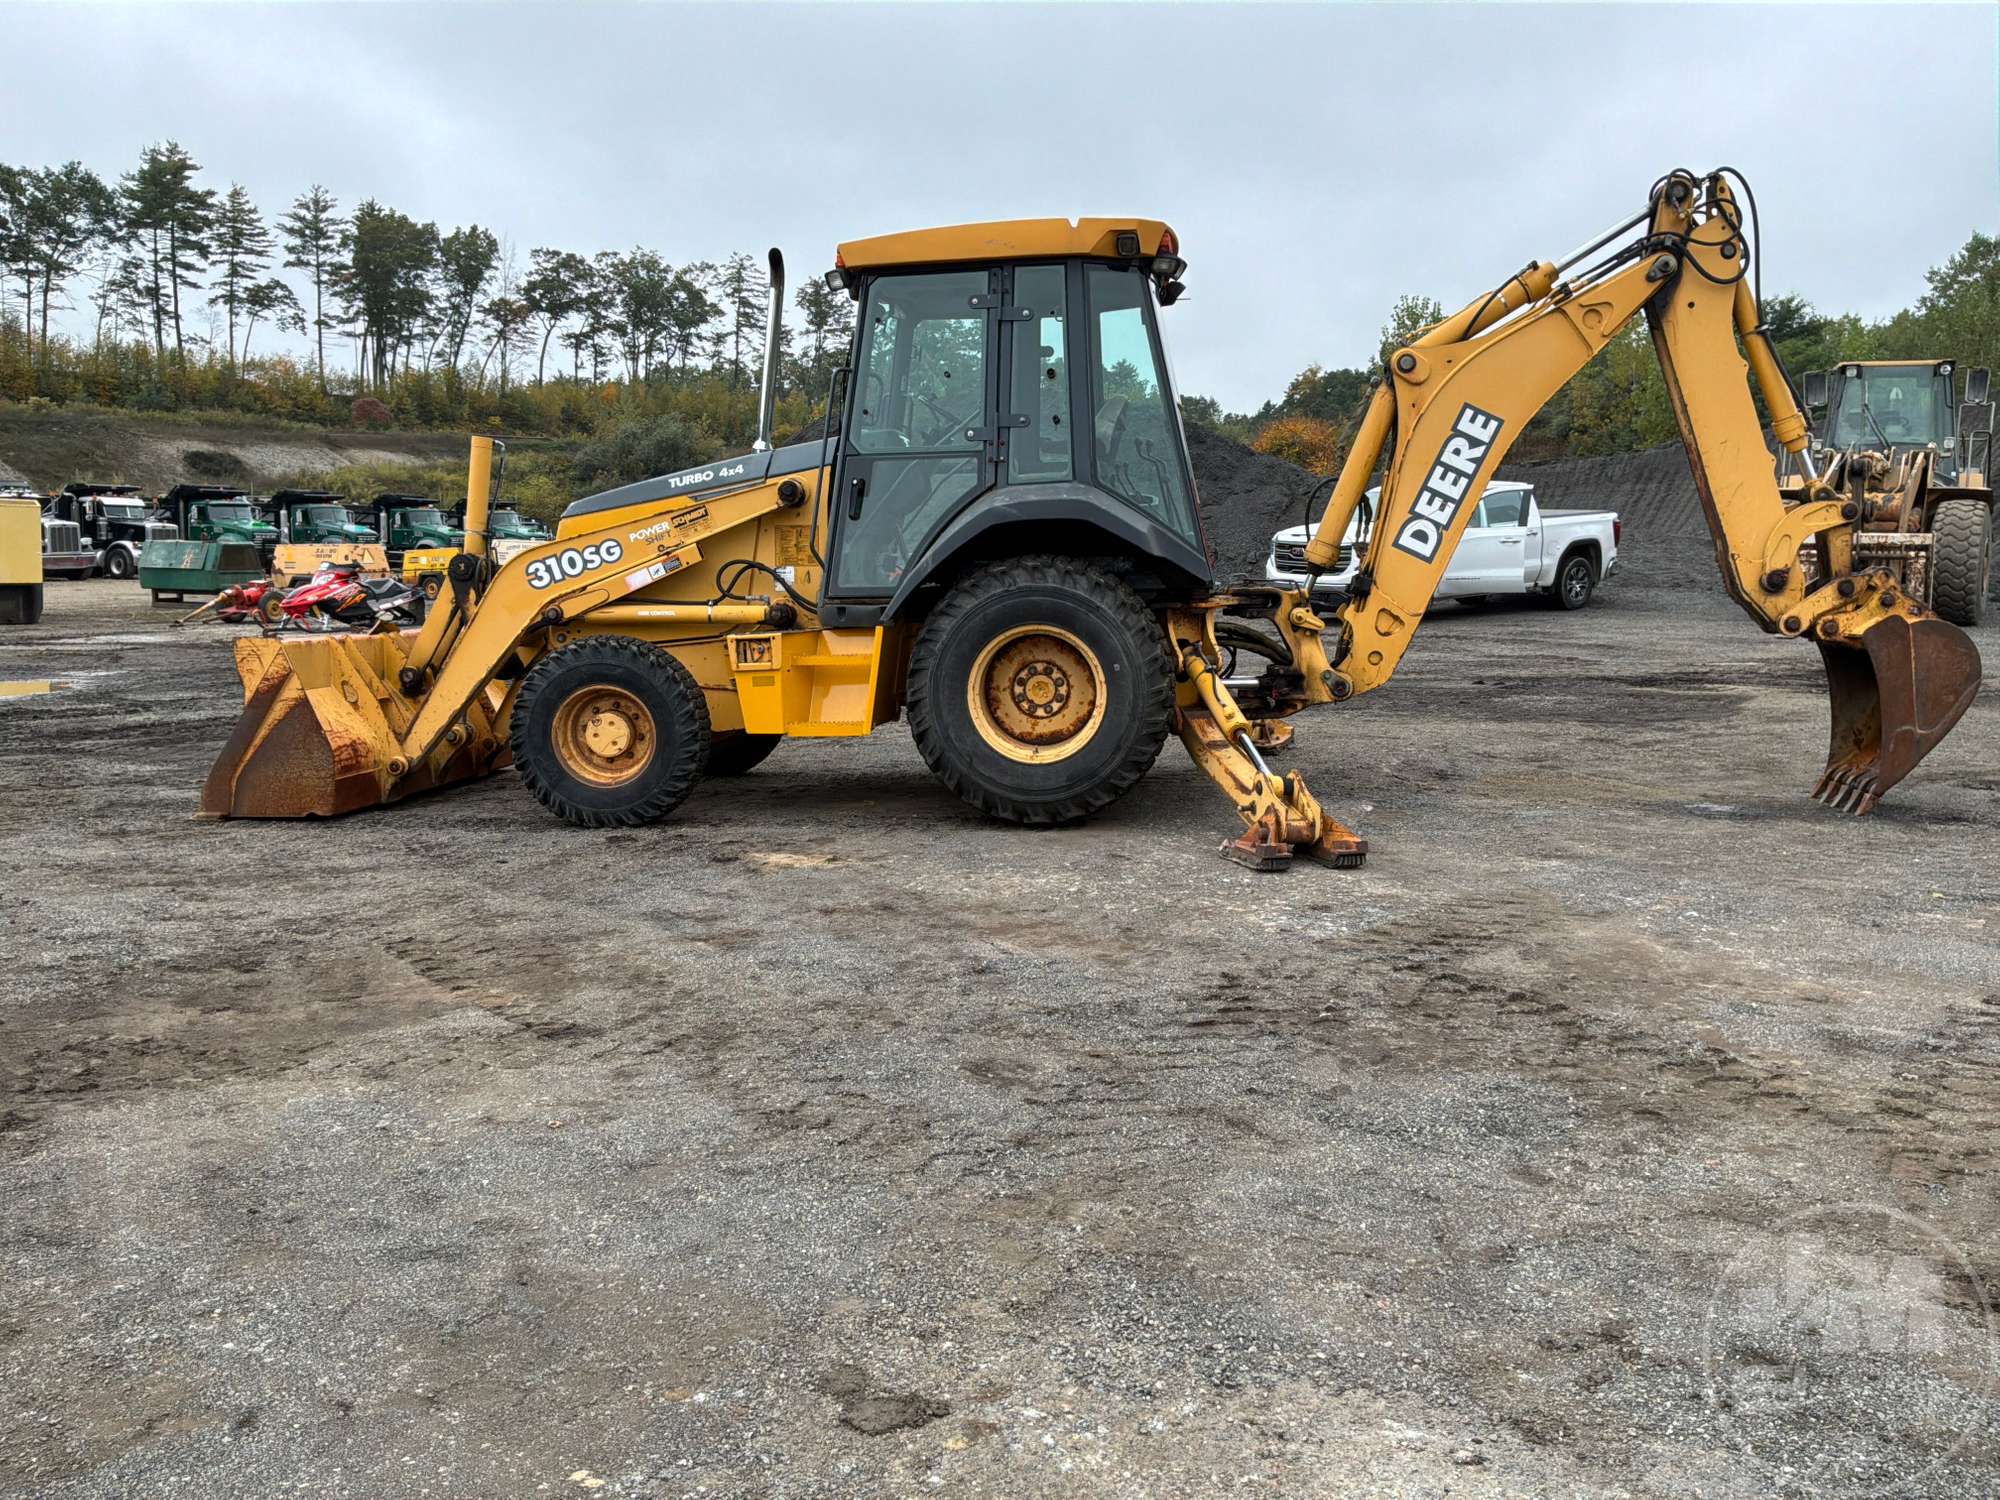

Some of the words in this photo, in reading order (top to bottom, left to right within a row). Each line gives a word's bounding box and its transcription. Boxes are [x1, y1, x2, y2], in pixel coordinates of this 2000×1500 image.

[668, 470, 714, 488] TURBO
[719, 464, 744, 477] 4x4
[1397, 405, 1500, 559] DEERE
[629, 520, 671, 543] POWER
[645, 530, 672, 546] SHIFT
[526, 540, 622, 589] 310SG
